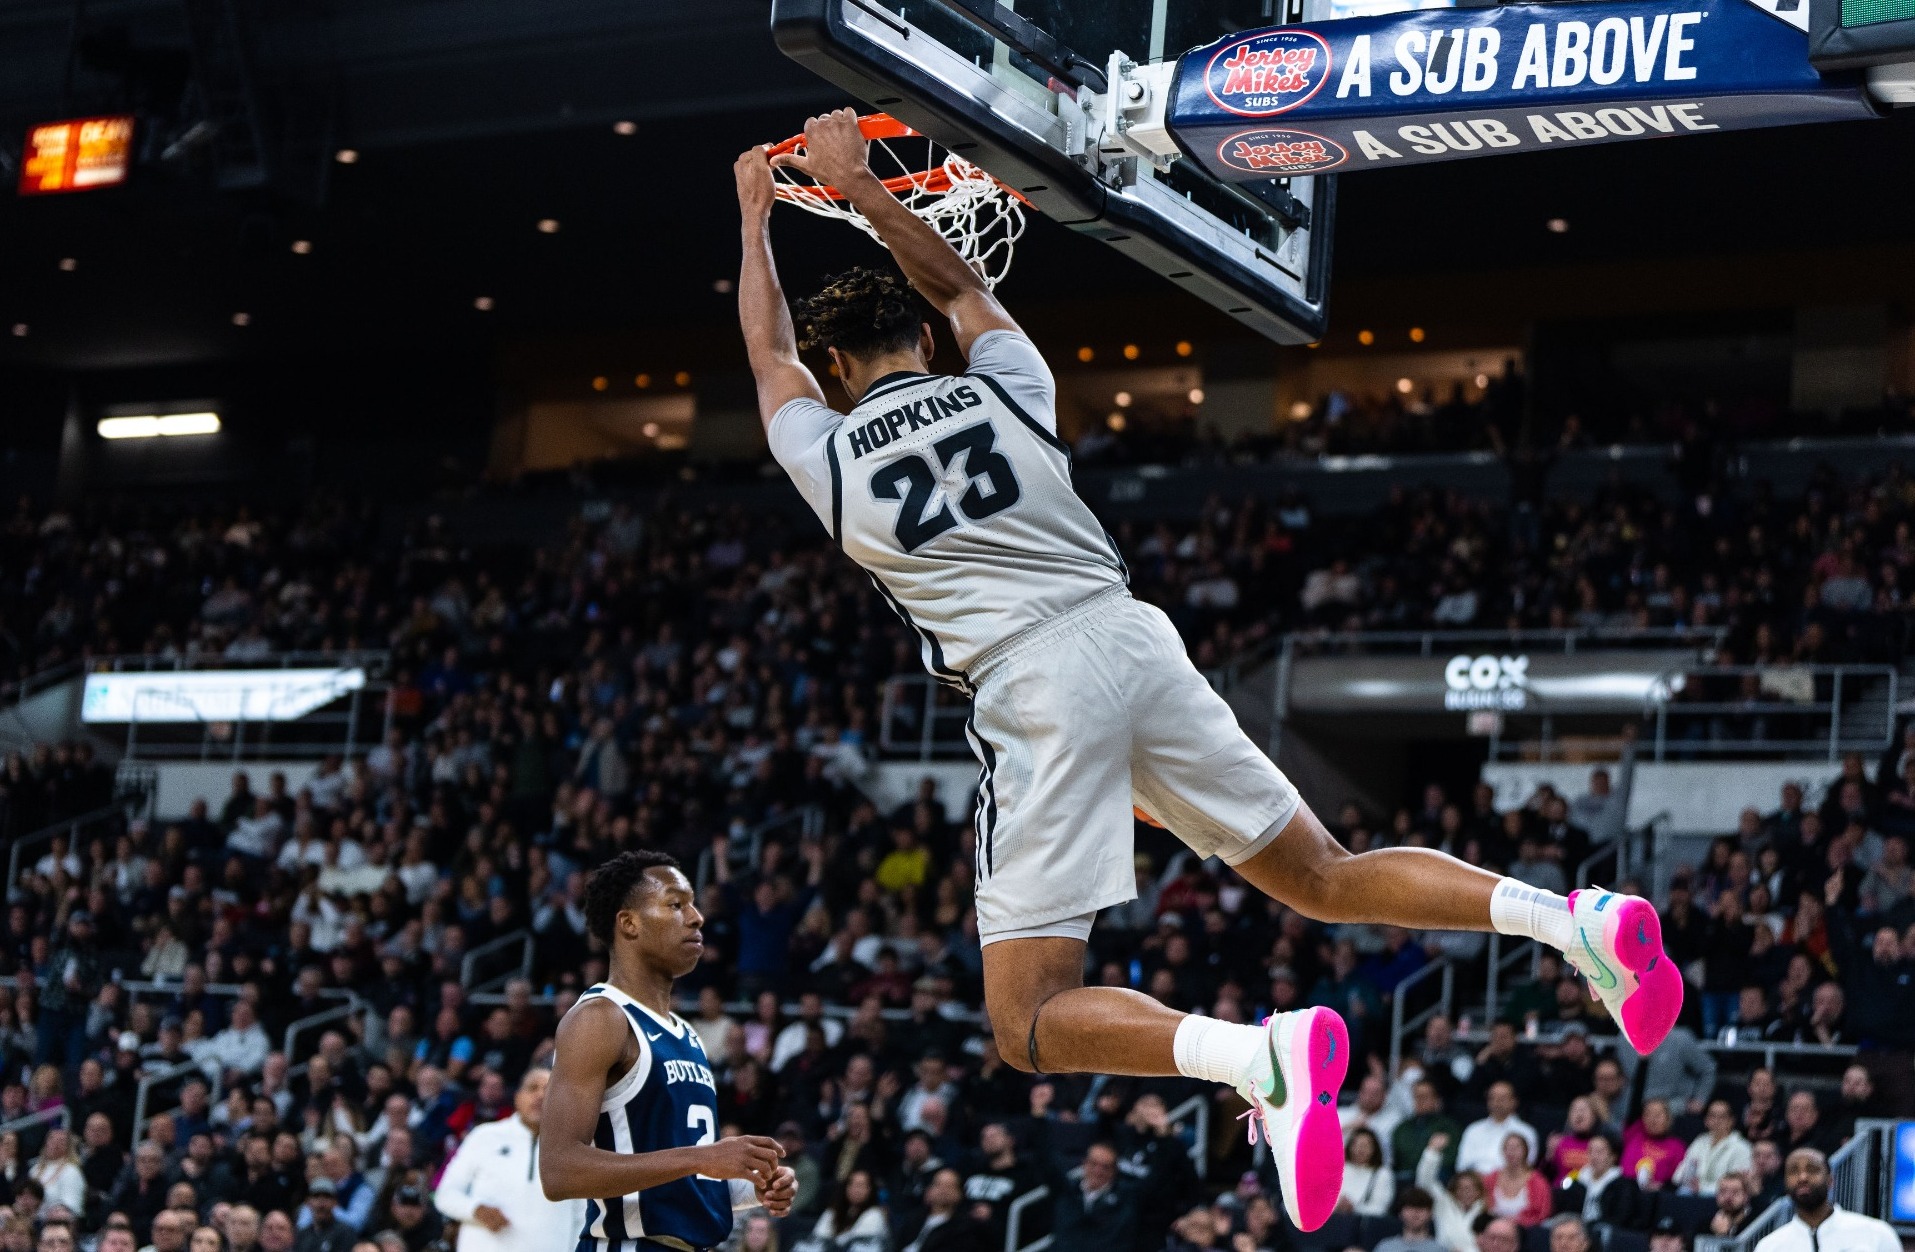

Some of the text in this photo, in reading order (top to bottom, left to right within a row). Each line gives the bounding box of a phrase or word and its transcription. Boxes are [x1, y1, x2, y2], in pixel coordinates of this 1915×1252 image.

[1256, 37, 1278, 45] SINCE
[1336, 11, 1702, 98] A SUB ABOVE
[1223, 44, 1317, 73] Jersey
[1222, 67, 1310, 95] Mike's
[1244, 96, 1279, 107] SUBS
[1353, 103, 1720, 161] A SUB ABOVE
[1233, 141, 1327, 158] Jersey
[1280, 163, 1315, 171] SUBS
[847, 385, 983, 460] HOPKINS
[867, 417, 1025, 555] 23
[1445, 654, 1530, 691] COX
